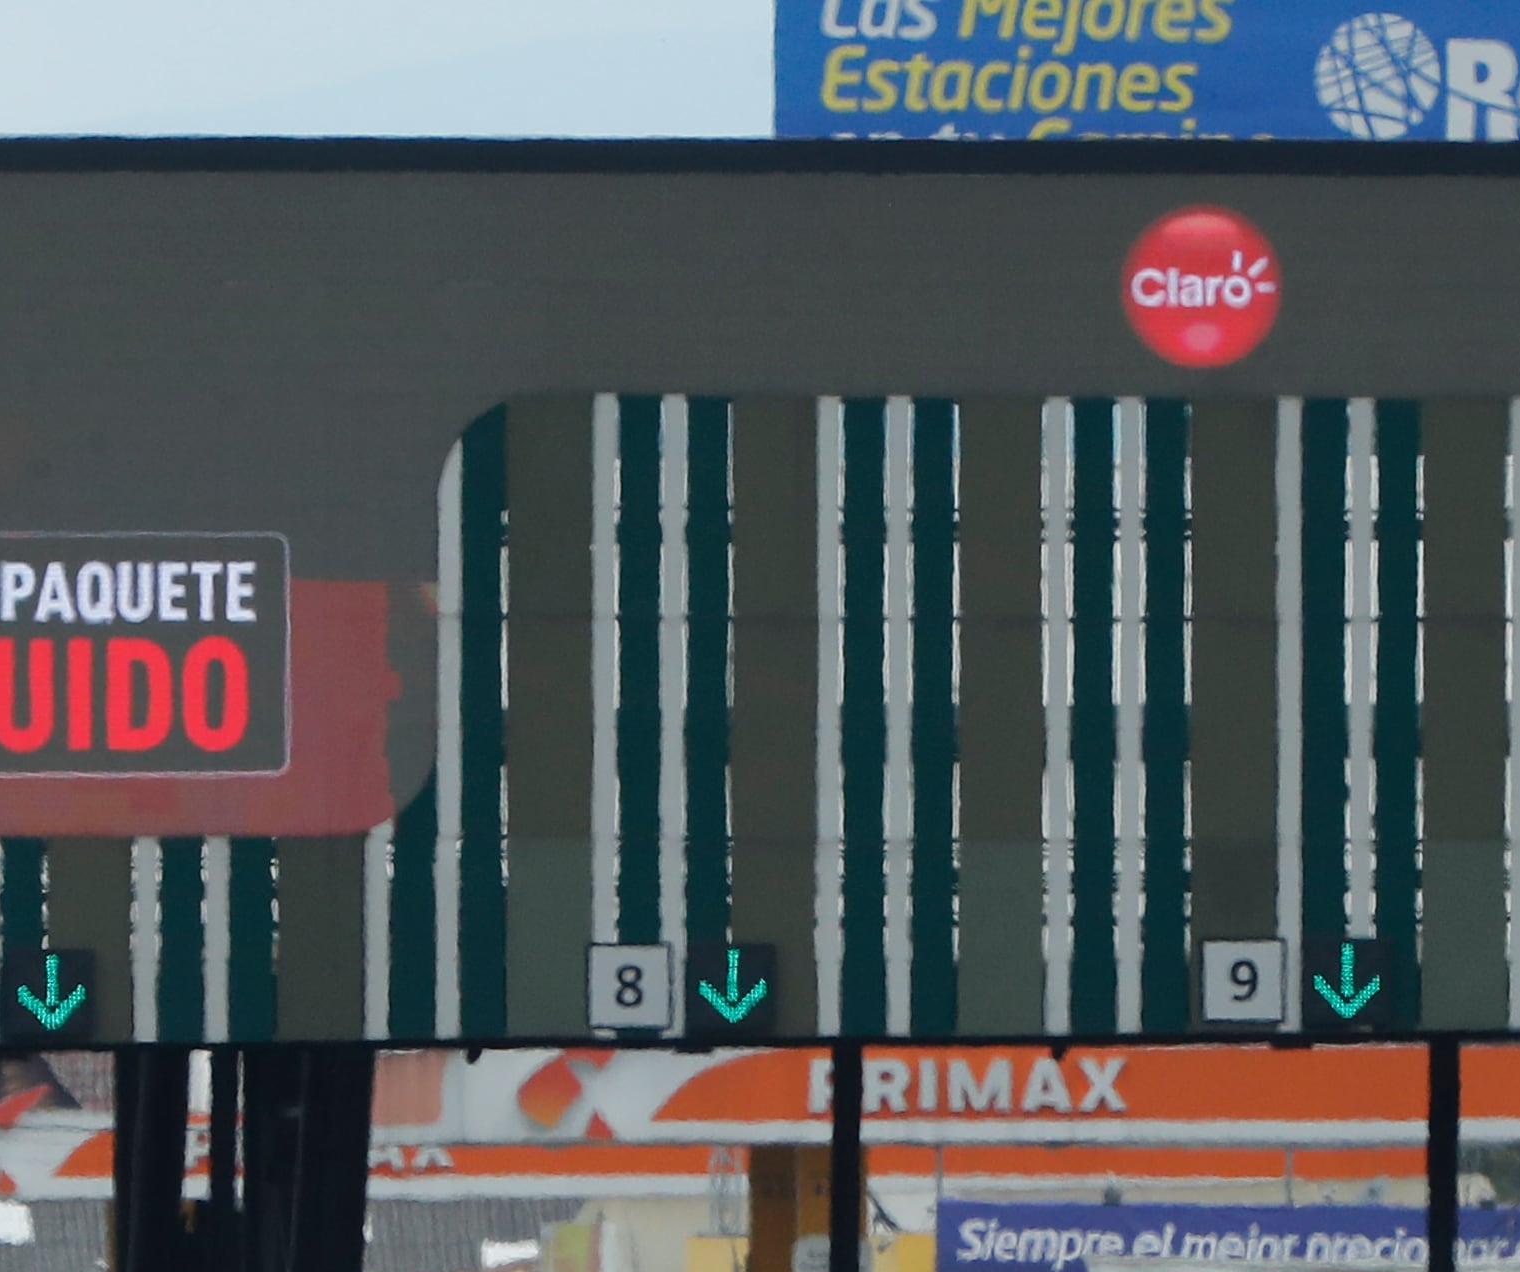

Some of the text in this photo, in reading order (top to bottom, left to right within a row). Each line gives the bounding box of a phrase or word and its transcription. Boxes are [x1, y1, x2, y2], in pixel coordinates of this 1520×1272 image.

[820, 0, 1233, 56] Las Mejores
[820, 43, 1198, 113] Estaciones
[1130, 266, 1252, 309] Claro
[0, 560, 258, 624] PAQUETE
[617, 963, 643, 1008] 8
[1230, 959, 1259, 1001] 9
[807, 1057, 1127, 1115] PRIMAX
[956, 1217, 1126, 1272] Siempre
[1132, 1221, 1177, 1258] el
